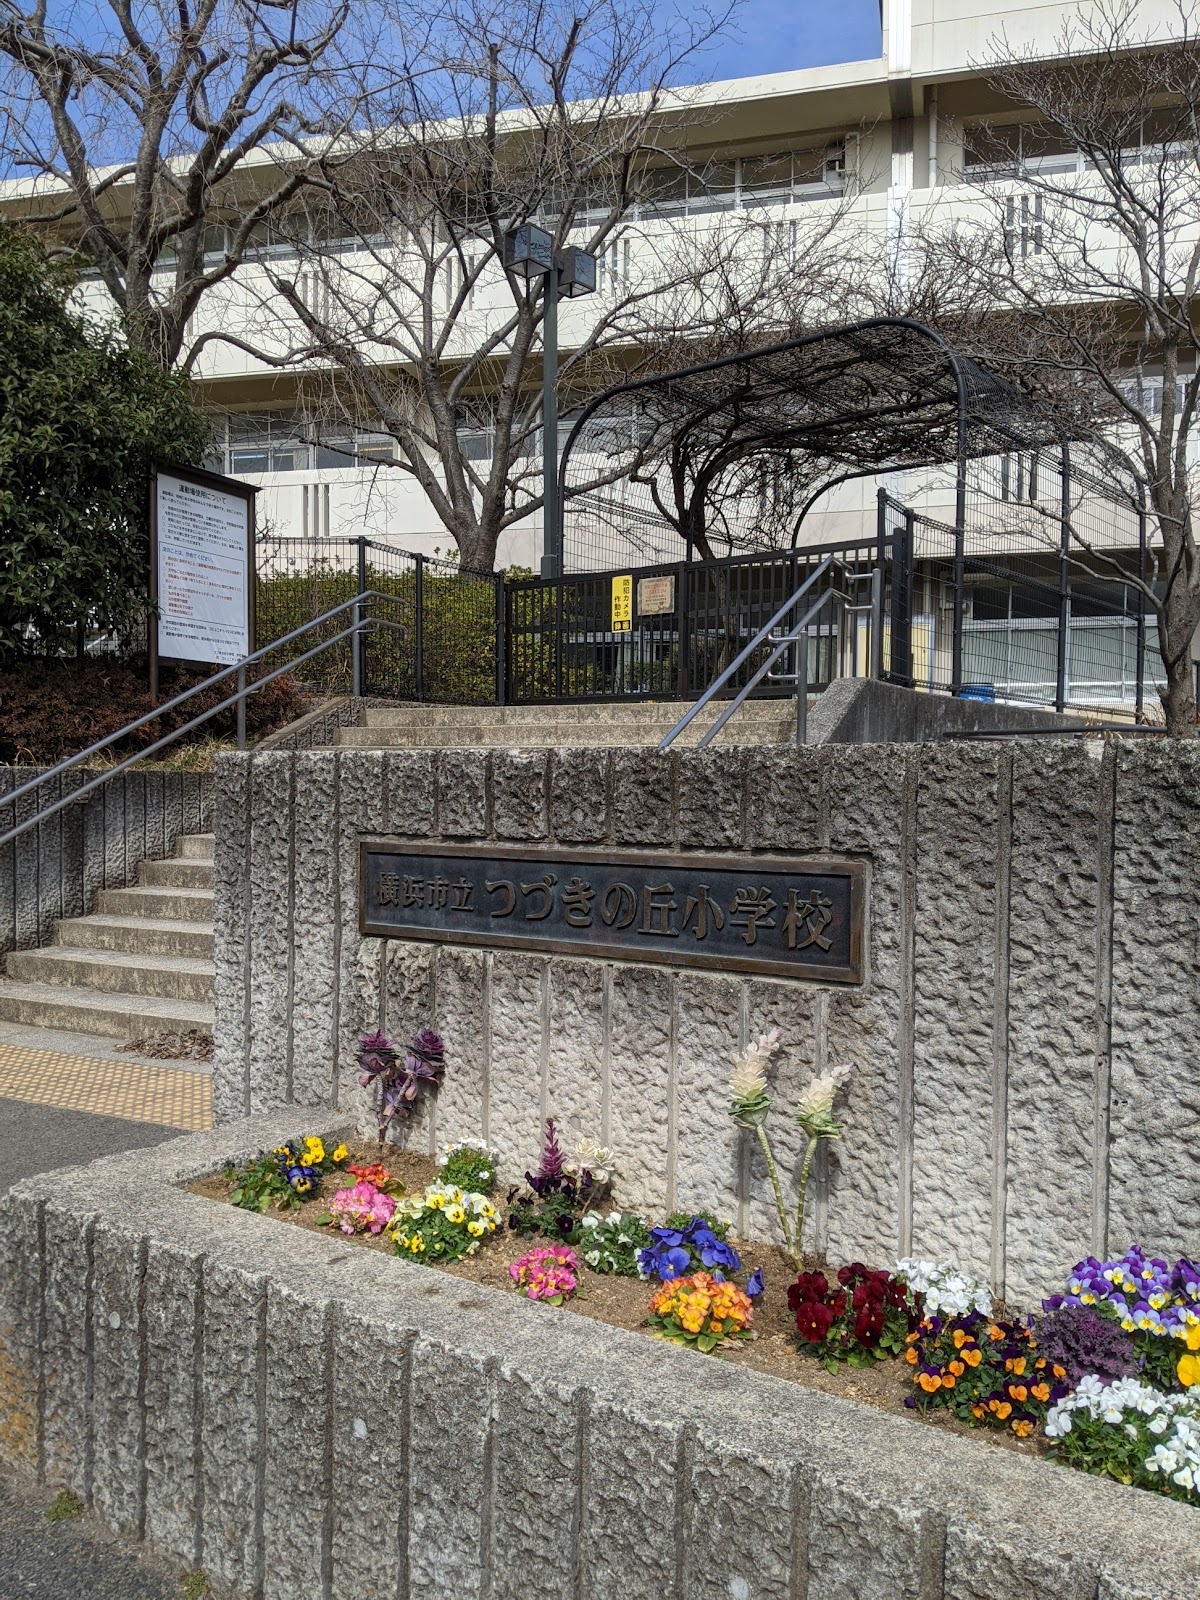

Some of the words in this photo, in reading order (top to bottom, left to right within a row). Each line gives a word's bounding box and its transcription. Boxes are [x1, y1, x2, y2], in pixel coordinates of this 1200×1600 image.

[178, 484, 227, 504] 運動場使用について
[622, 579, 630, 617] 防犯カメラ
[375, 871, 475, 912] 横浜市立
[484, 872, 834, 951] つづきの丘小学校
